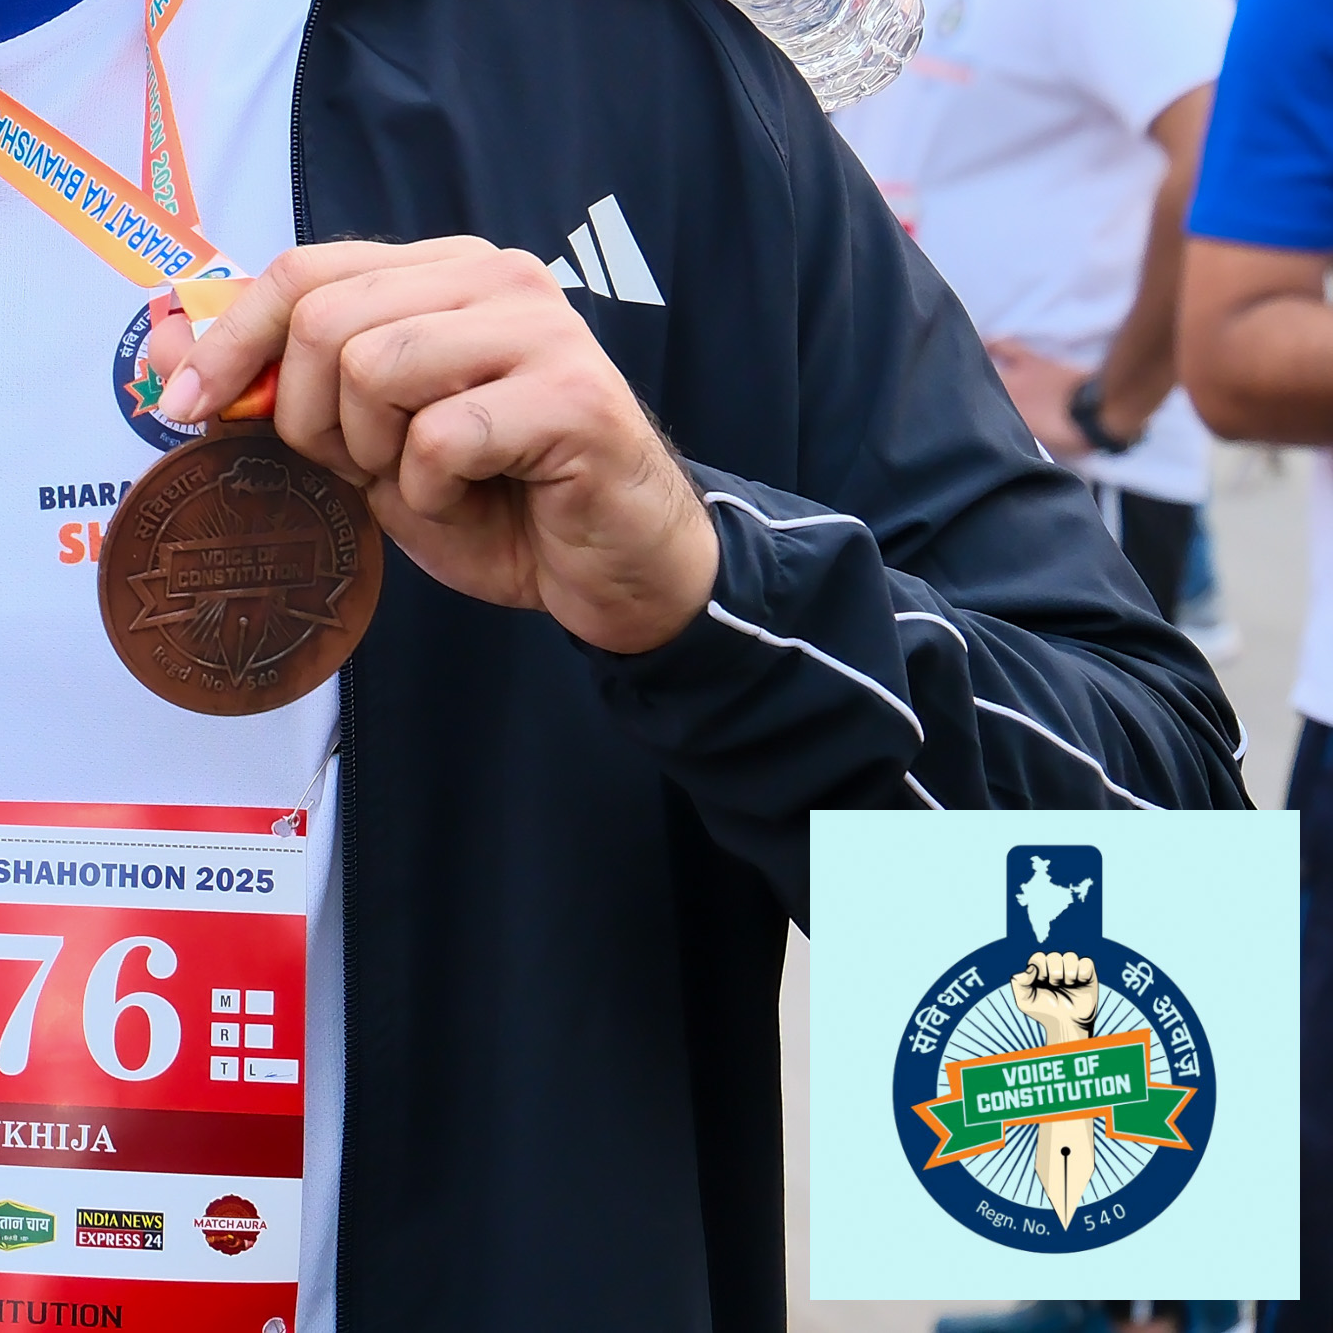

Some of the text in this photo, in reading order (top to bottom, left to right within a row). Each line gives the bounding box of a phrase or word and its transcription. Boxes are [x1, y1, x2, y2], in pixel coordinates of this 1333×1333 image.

[81, 178, 116, 222] KA
[103, 202, 196, 278] BHARAT
[39, 481, 133, 510] BHARA
[201, 548, 281, 565] VOICE OF
[178, 564, 303, 588] CONSTITUTION
[152, 645, 191, 681] Regd
[247, 670, 279, 691] 540
[195, 866, 275, 895] 2025
[220, 995, 231, 1007] M
[220, 1029, 229, 1041] R
[220, 1062, 256, 1076] T L
[26, 1215, 50, 1232] चाय
[78, 1212, 162, 1229] INDIA NEWS
[78, 1231, 162, 1248] EXPRESS 24
